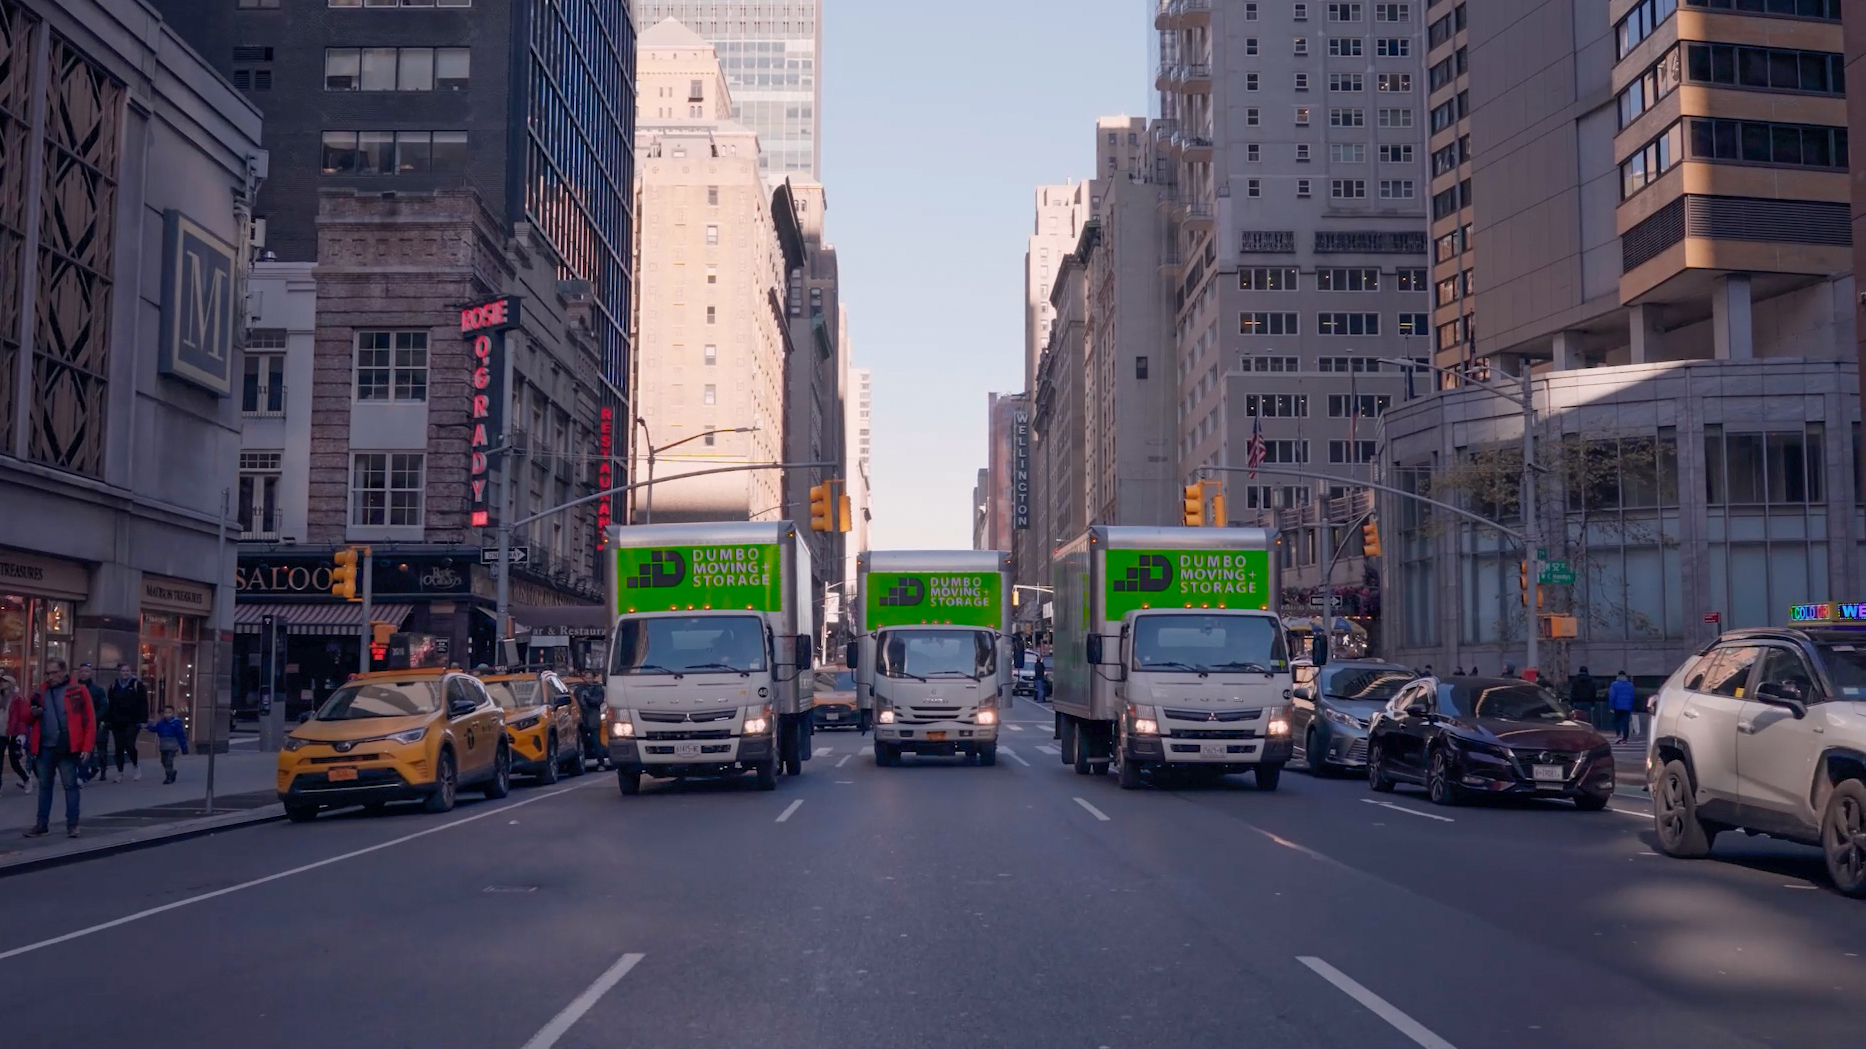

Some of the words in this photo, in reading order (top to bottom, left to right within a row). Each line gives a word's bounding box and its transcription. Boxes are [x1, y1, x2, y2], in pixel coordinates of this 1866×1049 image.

[182, 250, 227, 362] M
[461, 300, 508, 332] ROSIE
[1015, 413, 1028, 526] WELLINGTON
[692, 548, 758, 561] DUMBO
[1180, 555, 1246, 568] DUMBO
[0, 562, 43, 580] TREASURES
[693, 562, 758, 575] MOVING
[1180, 568, 1245, 580] MOVING
[236, 566, 358, 591] SALOO
[693, 574, 770, 587] STORAGE
[930, 577, 981, 587] DUMBO
[930, 587, 980, 597] MOVING
[1180, 581, 1256, 594] STORAGE
[930, 597, 989, 607] STORAGE
